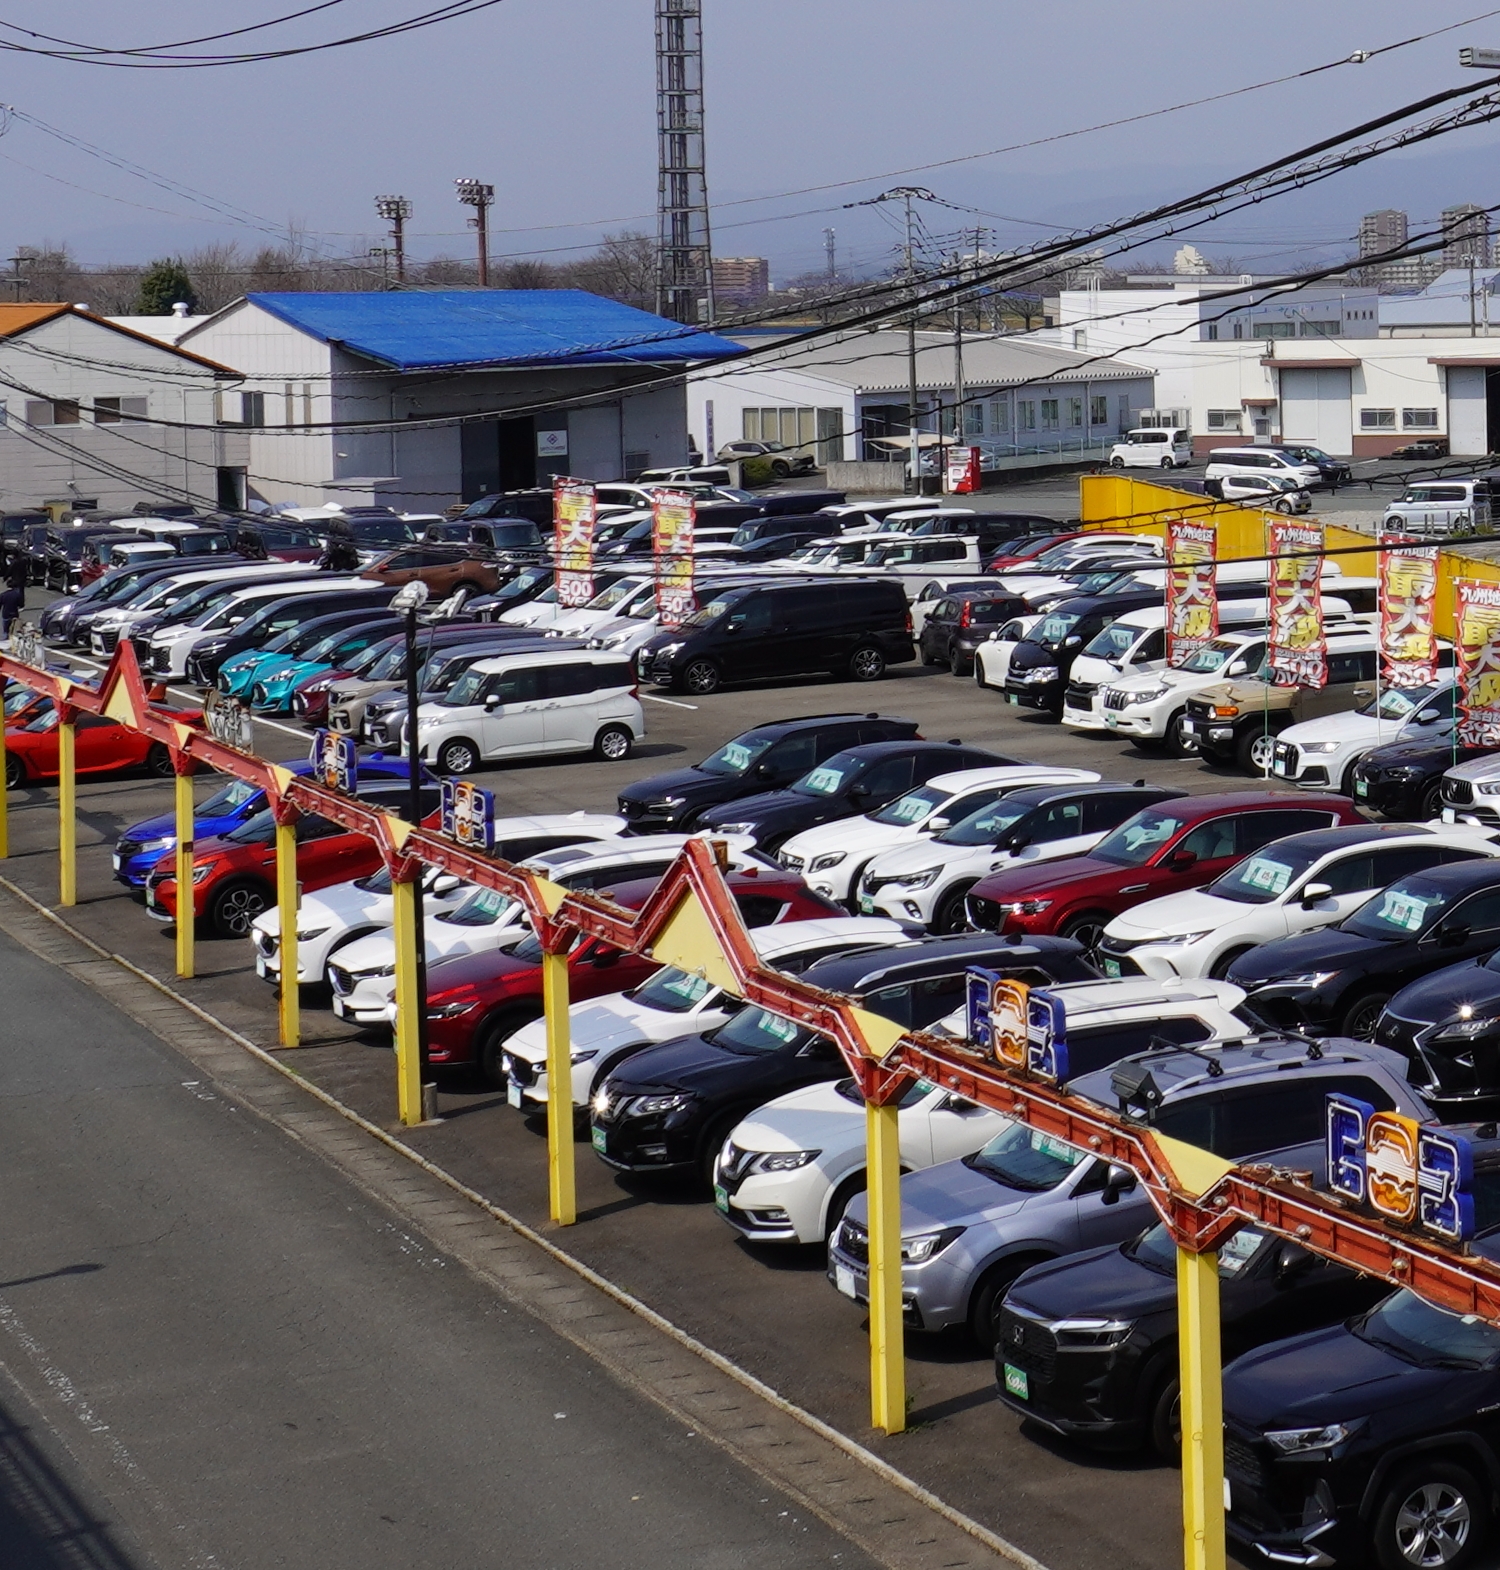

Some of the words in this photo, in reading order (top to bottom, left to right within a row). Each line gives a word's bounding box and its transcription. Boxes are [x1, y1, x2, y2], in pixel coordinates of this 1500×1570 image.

[1171, 525, 1214, 543] 九州地区
[1275, 526, 1322, 544] 九州地区
[559, 580, 593, 596] 500
[1172, 540, 1214, 638] 最大級
[1273, 543, 1321, 648] 最大級
[661, 596, 696, 613] 500
[1385, 557, 1436, 660] 最大級
[1274, 657, 1323, 679] 500
